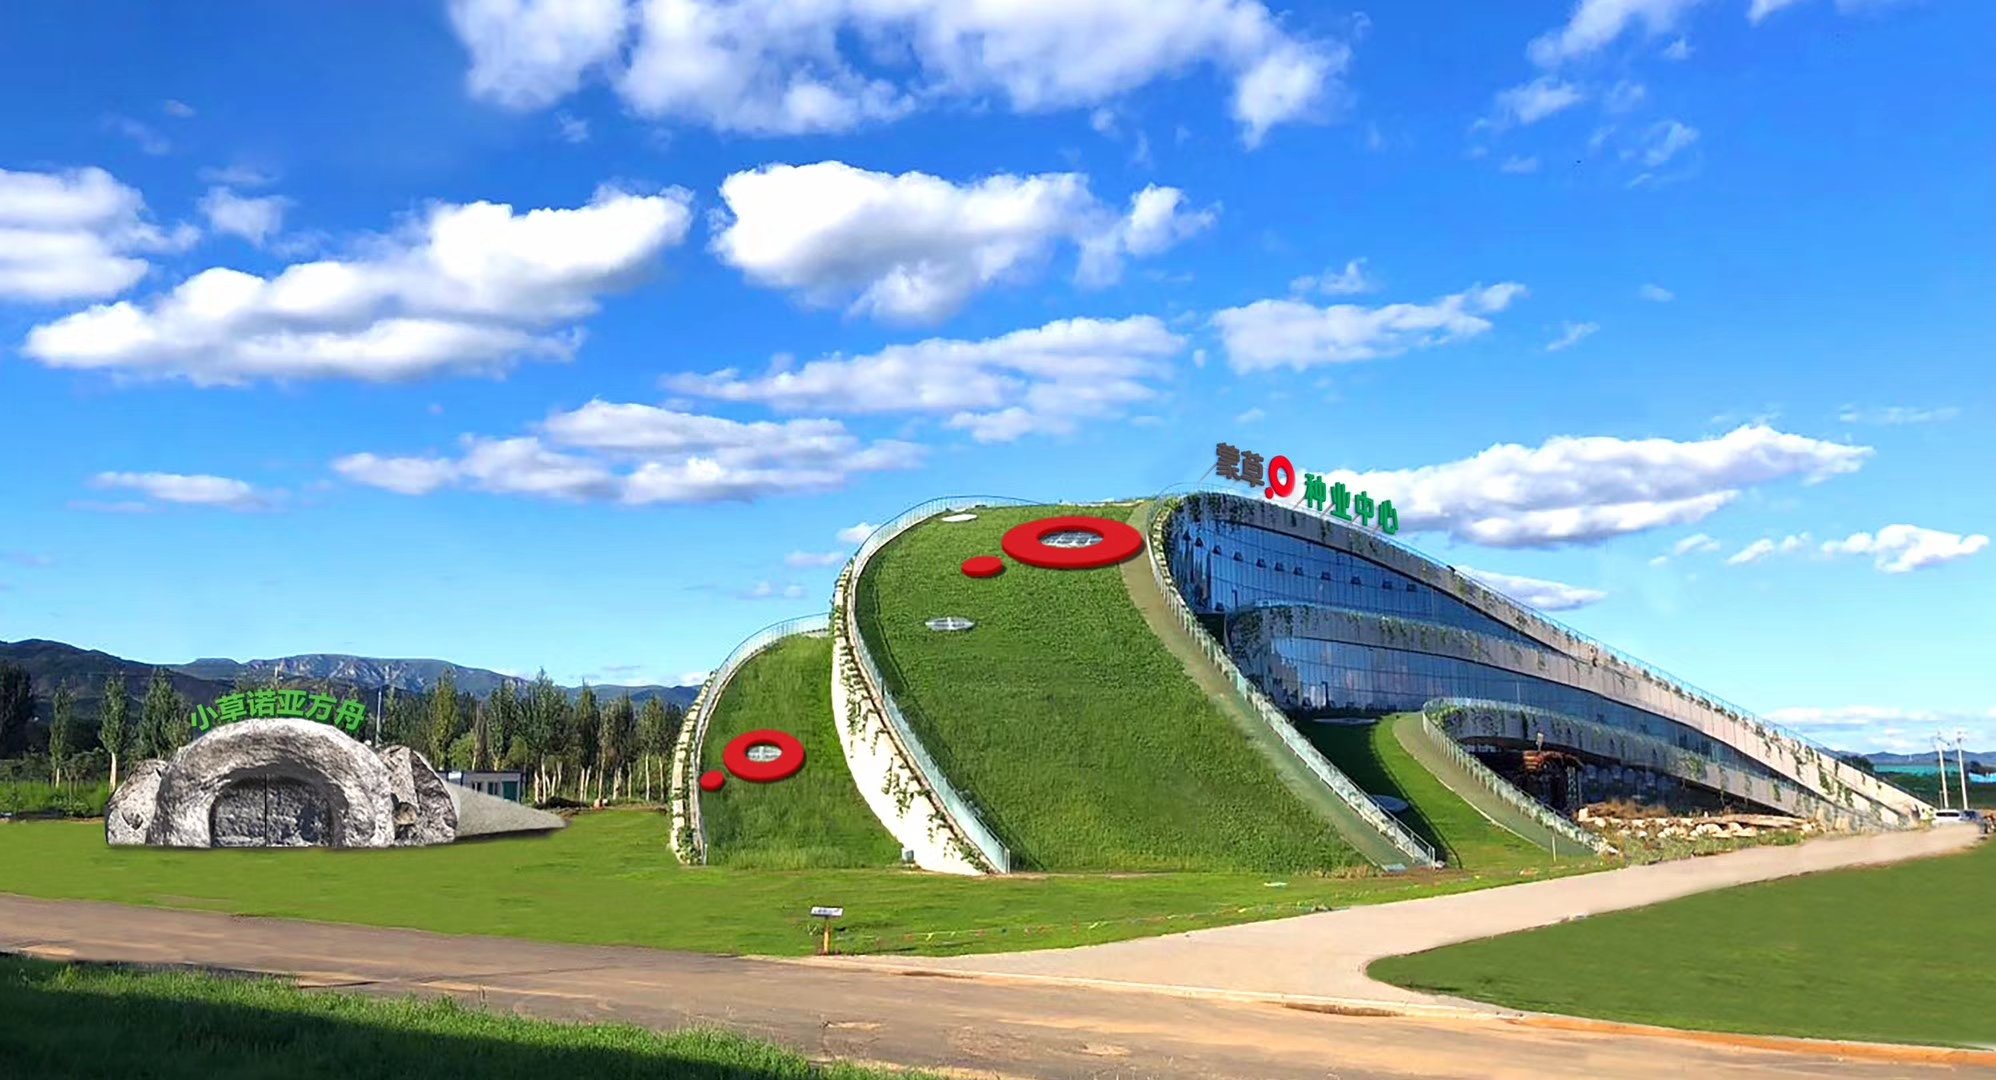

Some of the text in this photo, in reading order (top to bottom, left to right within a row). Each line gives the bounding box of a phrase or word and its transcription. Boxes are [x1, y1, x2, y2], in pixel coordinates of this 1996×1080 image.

[1216, 442, 1398, 535] 蒙草 种业中心
[191, 688, 367, 732] 小草诺亚方舟
